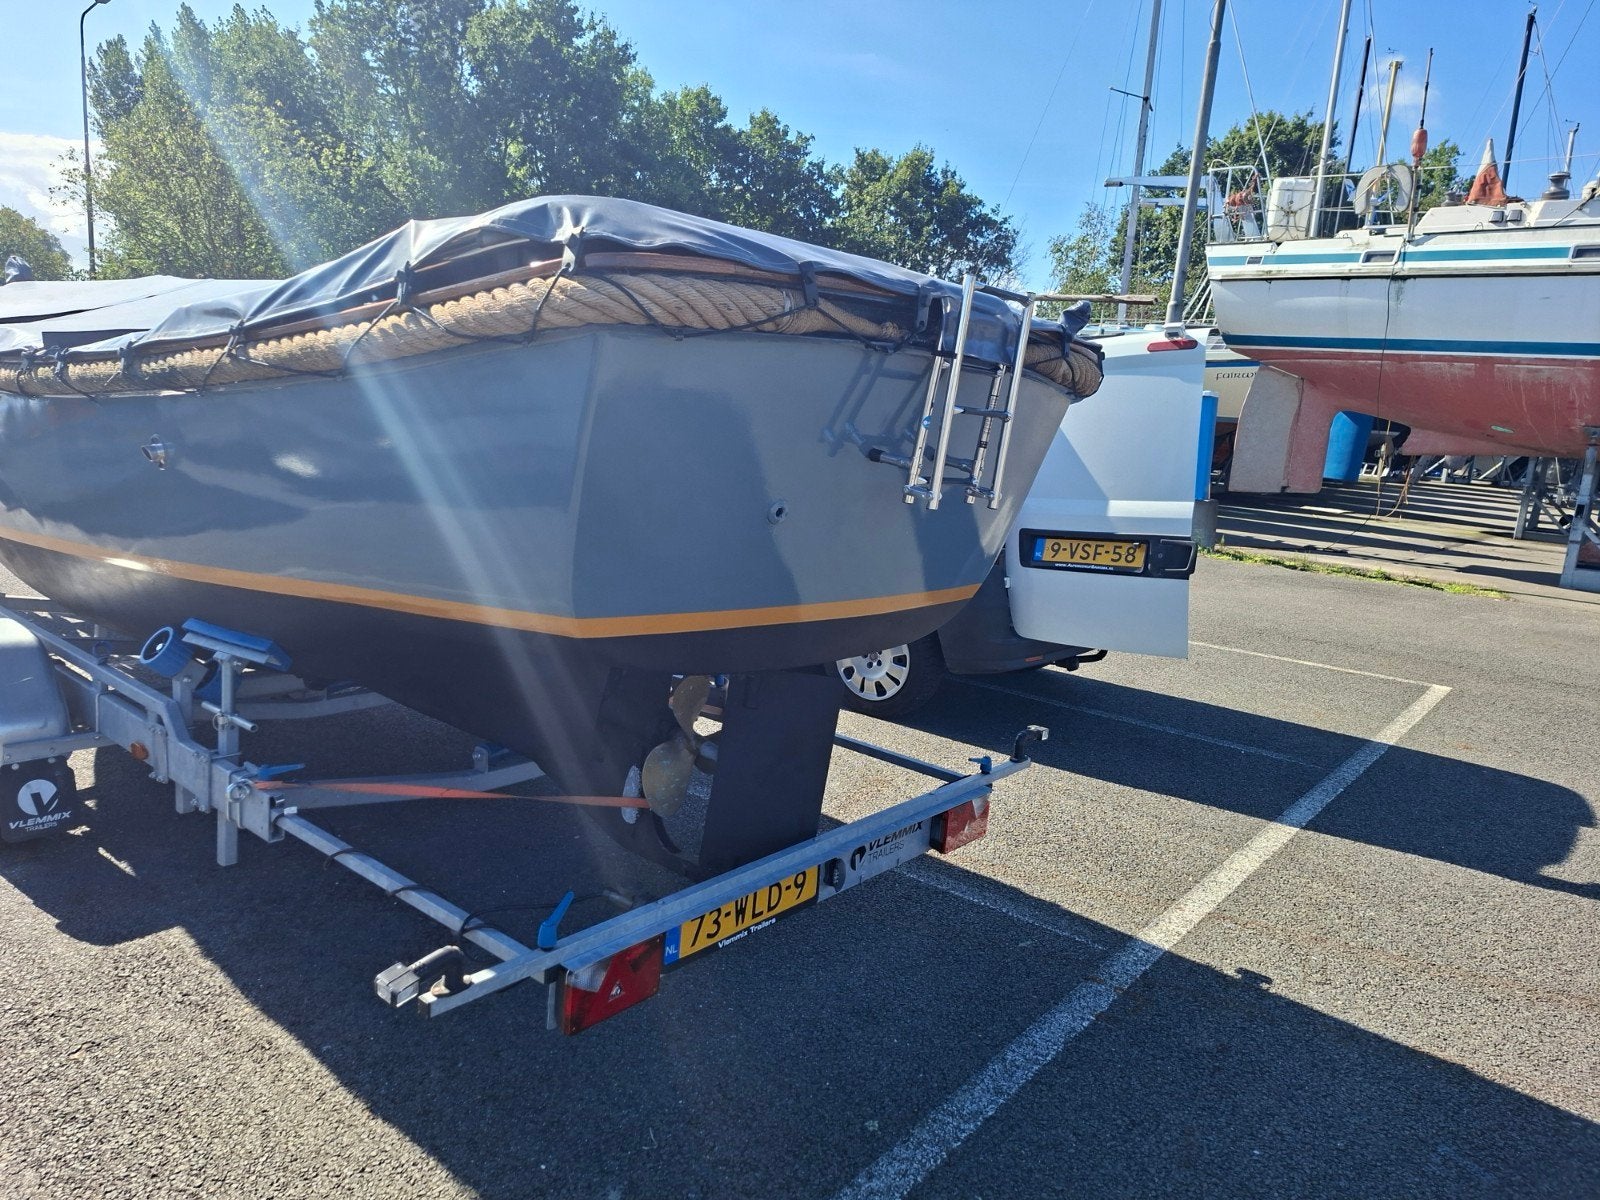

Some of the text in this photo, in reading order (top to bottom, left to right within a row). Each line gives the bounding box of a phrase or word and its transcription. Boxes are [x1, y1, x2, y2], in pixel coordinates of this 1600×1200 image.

[1050, 541, 1138, 564] 9-VSF-58
[9, 810, 72, 830] VLEMMIX
[25, 821, 58, 832] TRAILERS
[869, 820, 924, 852] VLEMMIX
[868, 840, 905, 862] TRAILERS
[690, 870, 807, 948] 73-WLD-9
[718, 917, 776, 949] Vlemmix Trailers
[665, 944, 678, 956] NL
